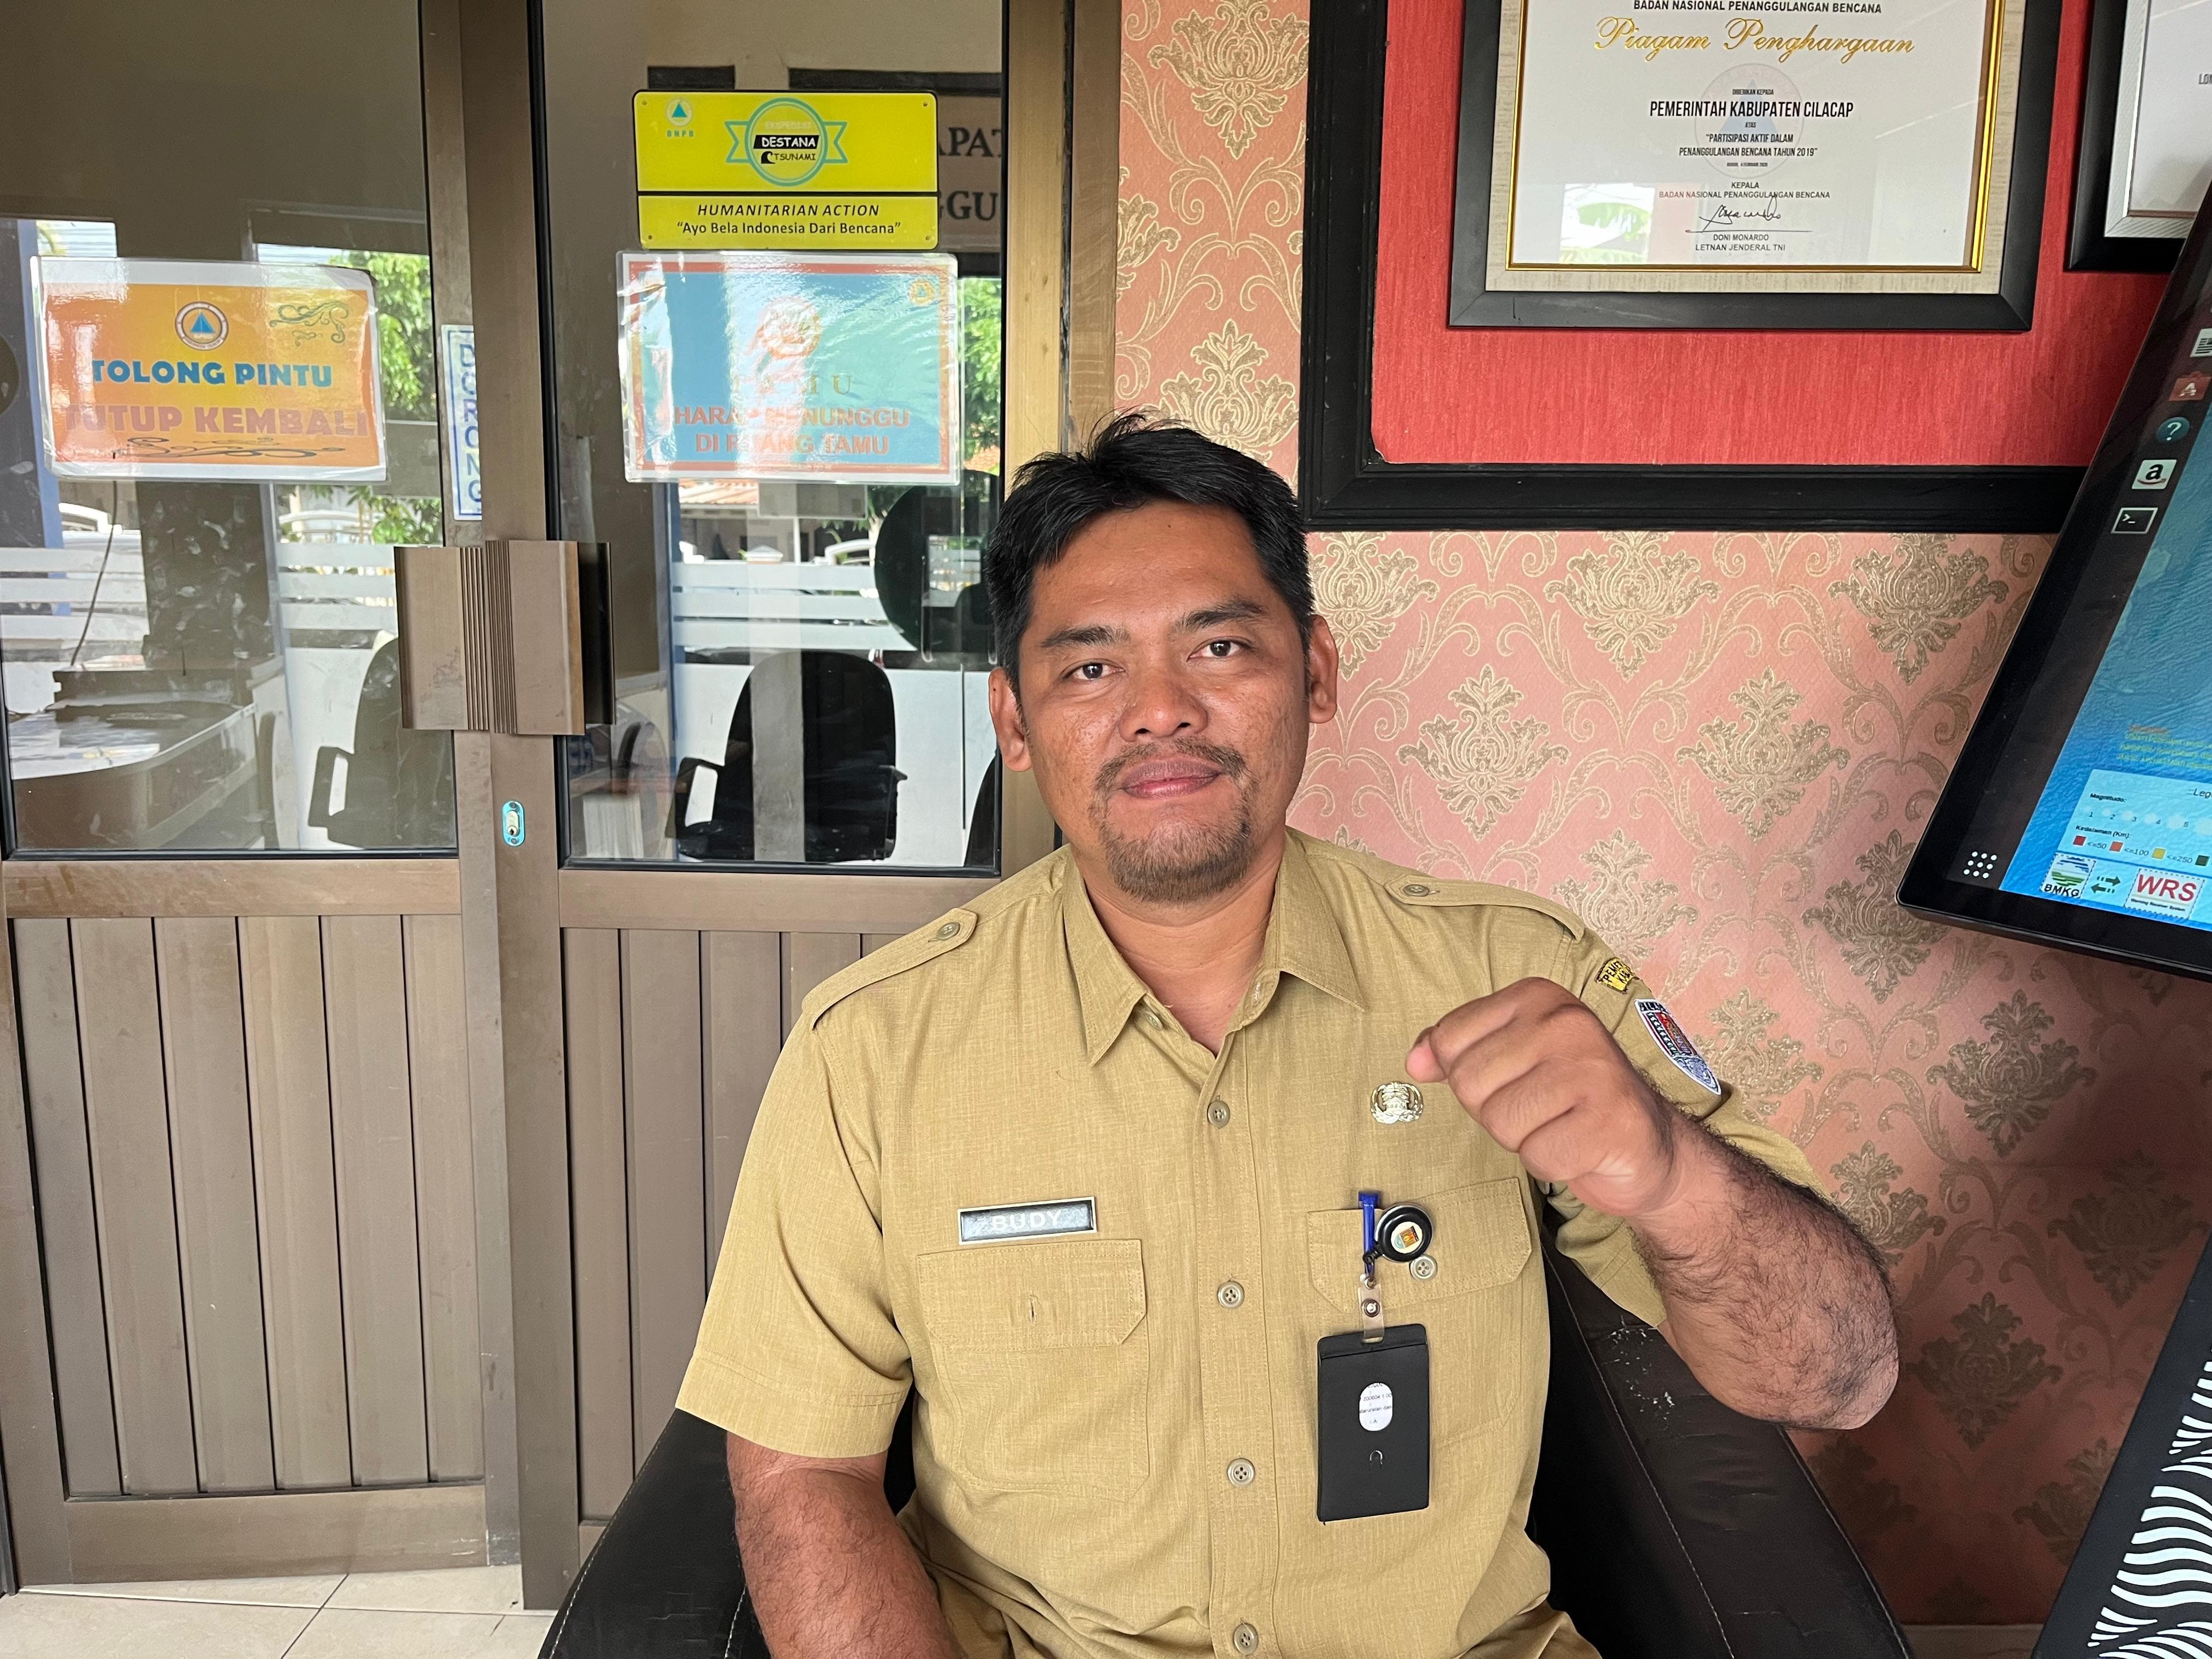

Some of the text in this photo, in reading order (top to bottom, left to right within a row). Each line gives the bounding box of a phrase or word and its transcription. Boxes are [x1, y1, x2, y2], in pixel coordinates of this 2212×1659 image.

[1634, 0, 1882, 13] BADAN NASIONAL PENANGGULANGAN BENCANA
[1594, 16, 1915, 64] Piagam Penghargaan
[1650, 101, 1854, 117] PEMERINTAH KABUPATEN CILACAP
[761, 137, 816, 148] DESTANA
[1750, 133, 1770, 143] AKTIF
[1770, 133, 1793, 143] DALAM
[774, 153, 816, 161] TSUNAMI
[1679, 147, 1740, 156] PENANGGULANGAN
[1741, 147, 1772, 156] BENCANA
[1774, 148, 1795, 156] TAHUN
[697, 204, 879, 216] HUMANITARIAN ACTION
[711, 222, 738, 234] Bela
[743, 222, 805, 234] Indonesia
[809, 222, 836, 234] Dari
[91, 359, 332, 387] TOLONG PINTU
[64, 404, 368, 436] TUTUP KEMBALI
[459, 343, 482, 503] DORONG
[696, 433, 889, 455] DI RANG TAMU
[2044, 884, 2080, 897] BMKG
[2137, 874, 2197, 901] WRS
[991, 1209, 1062, 1231] BUDY
